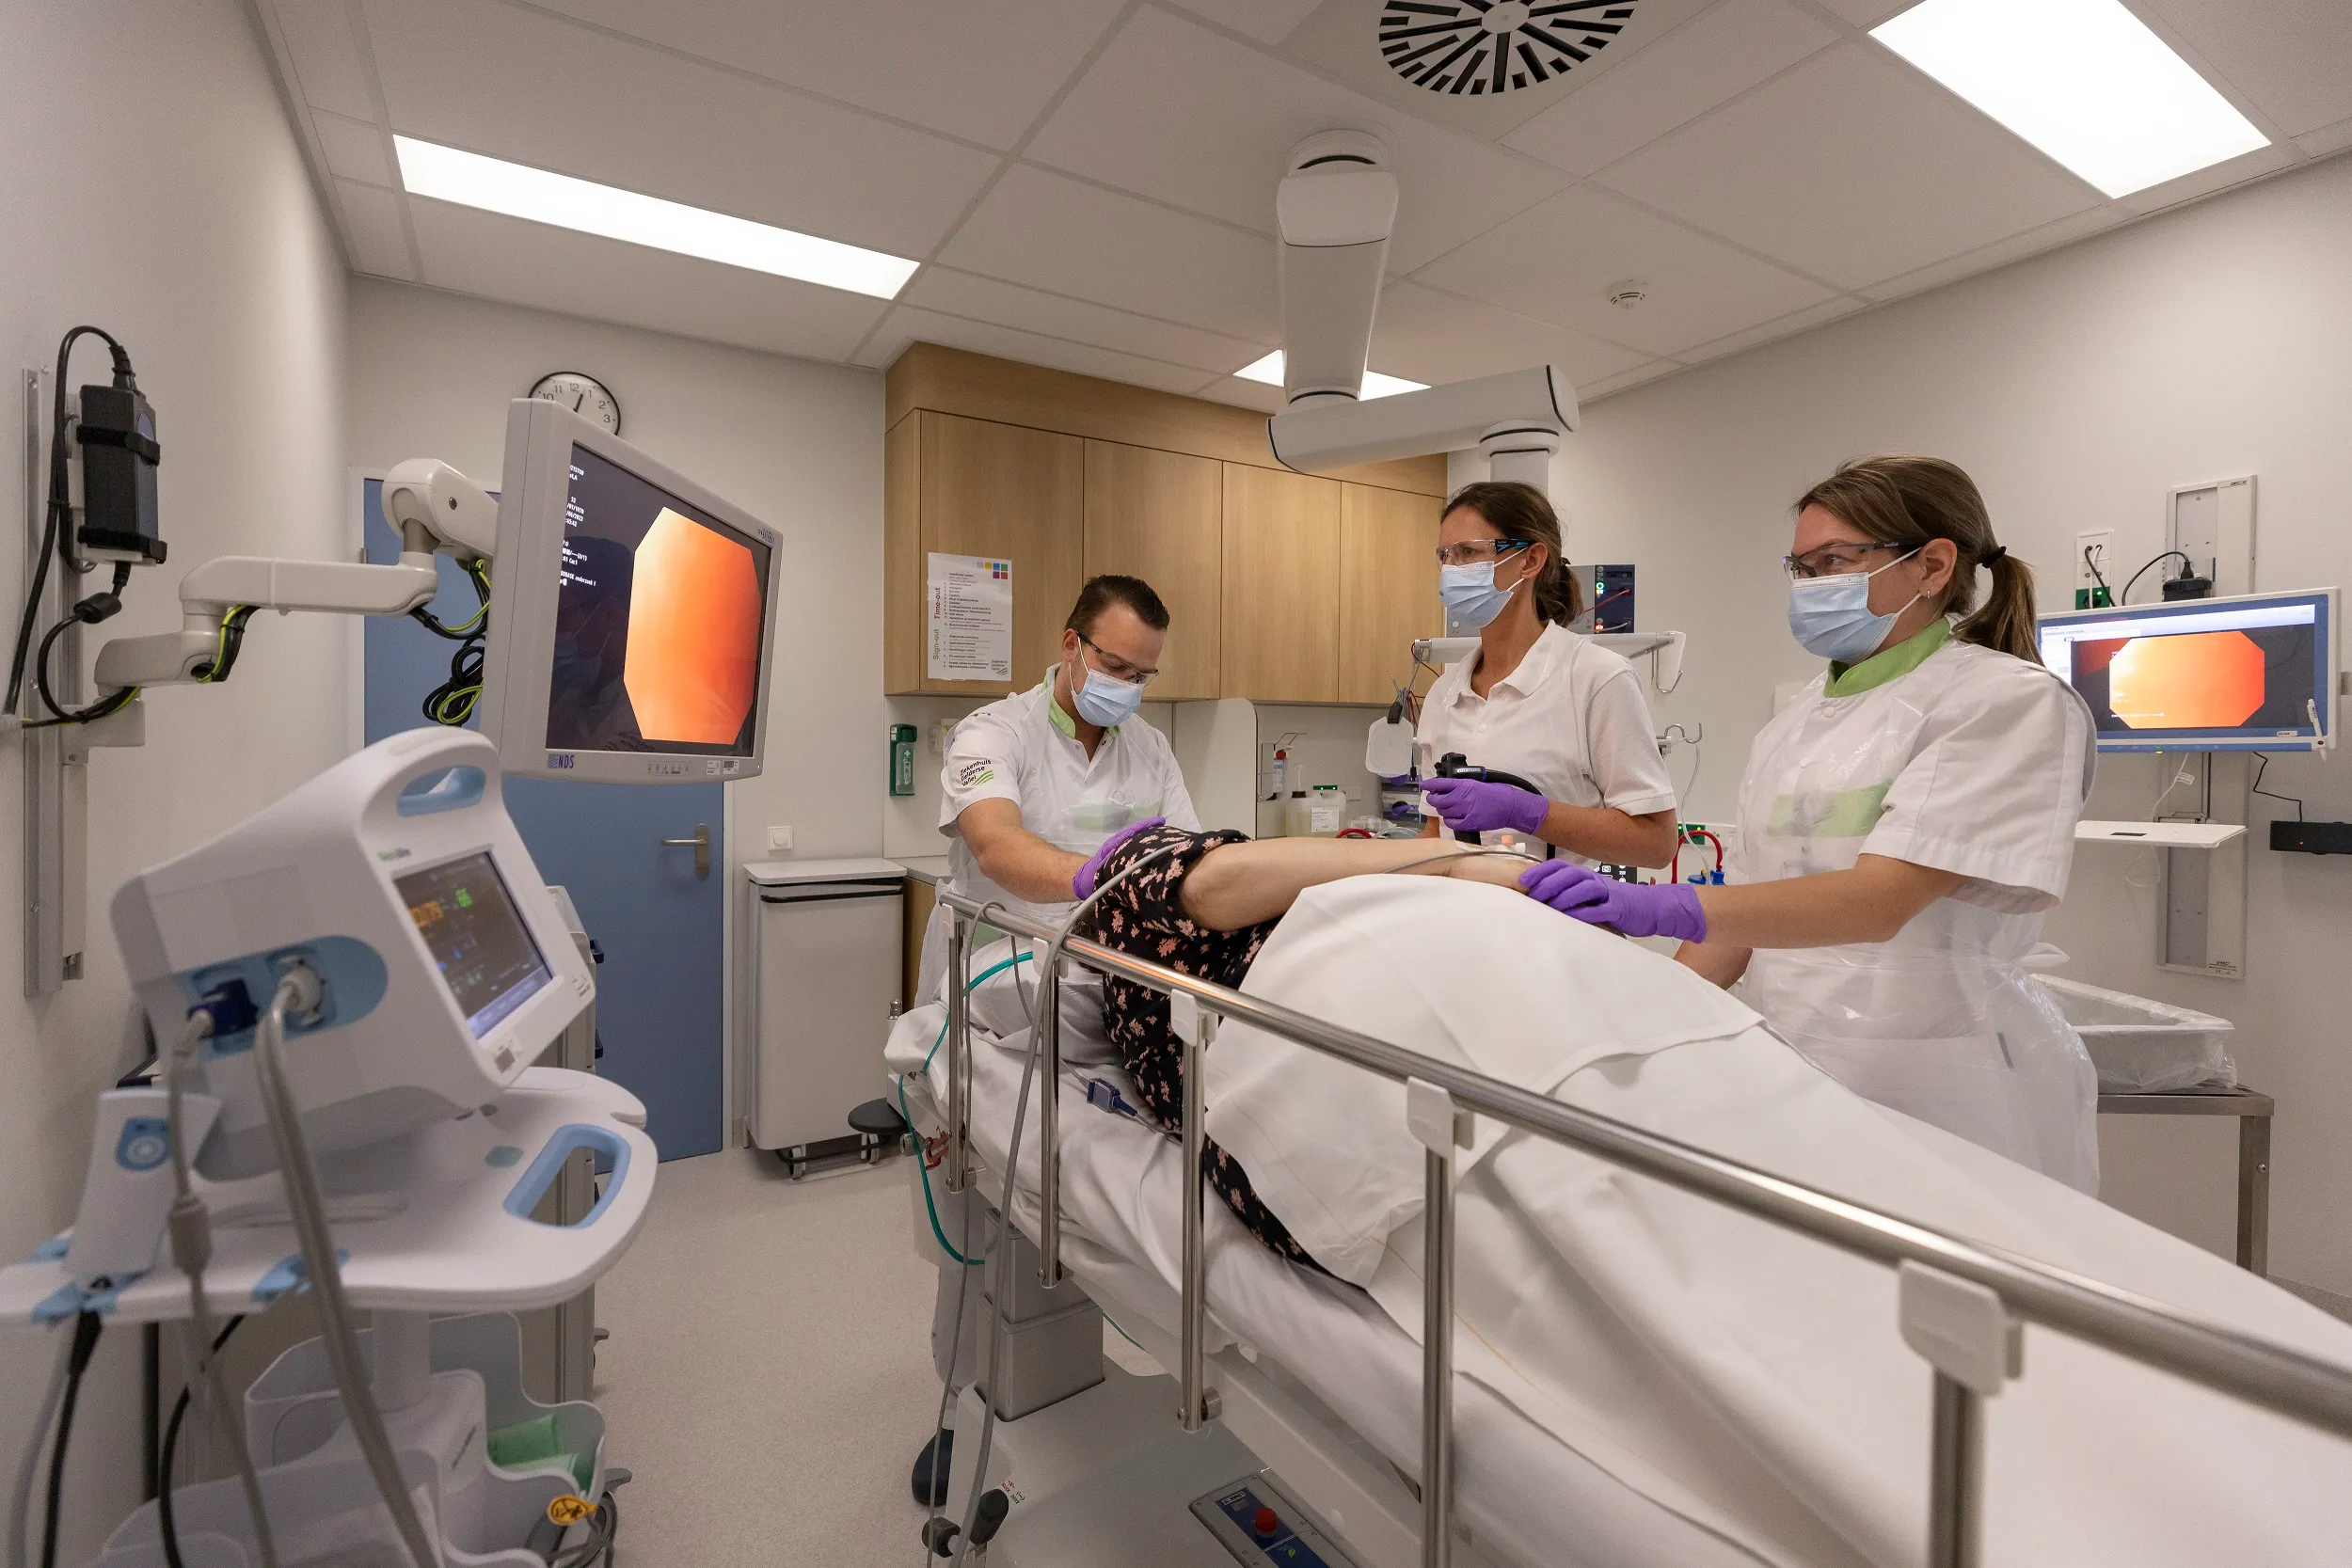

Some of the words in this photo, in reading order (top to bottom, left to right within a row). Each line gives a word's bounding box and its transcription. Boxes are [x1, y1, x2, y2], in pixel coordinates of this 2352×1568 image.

[554, 385, 563, 394] 11
[569, 383, 580, 392] 12
[588, 389, 593, 398] 1
[598, 400, 607, 409] 2
[603, 414, 612, 423] 3
[558, 754, 575, 768] NDS
